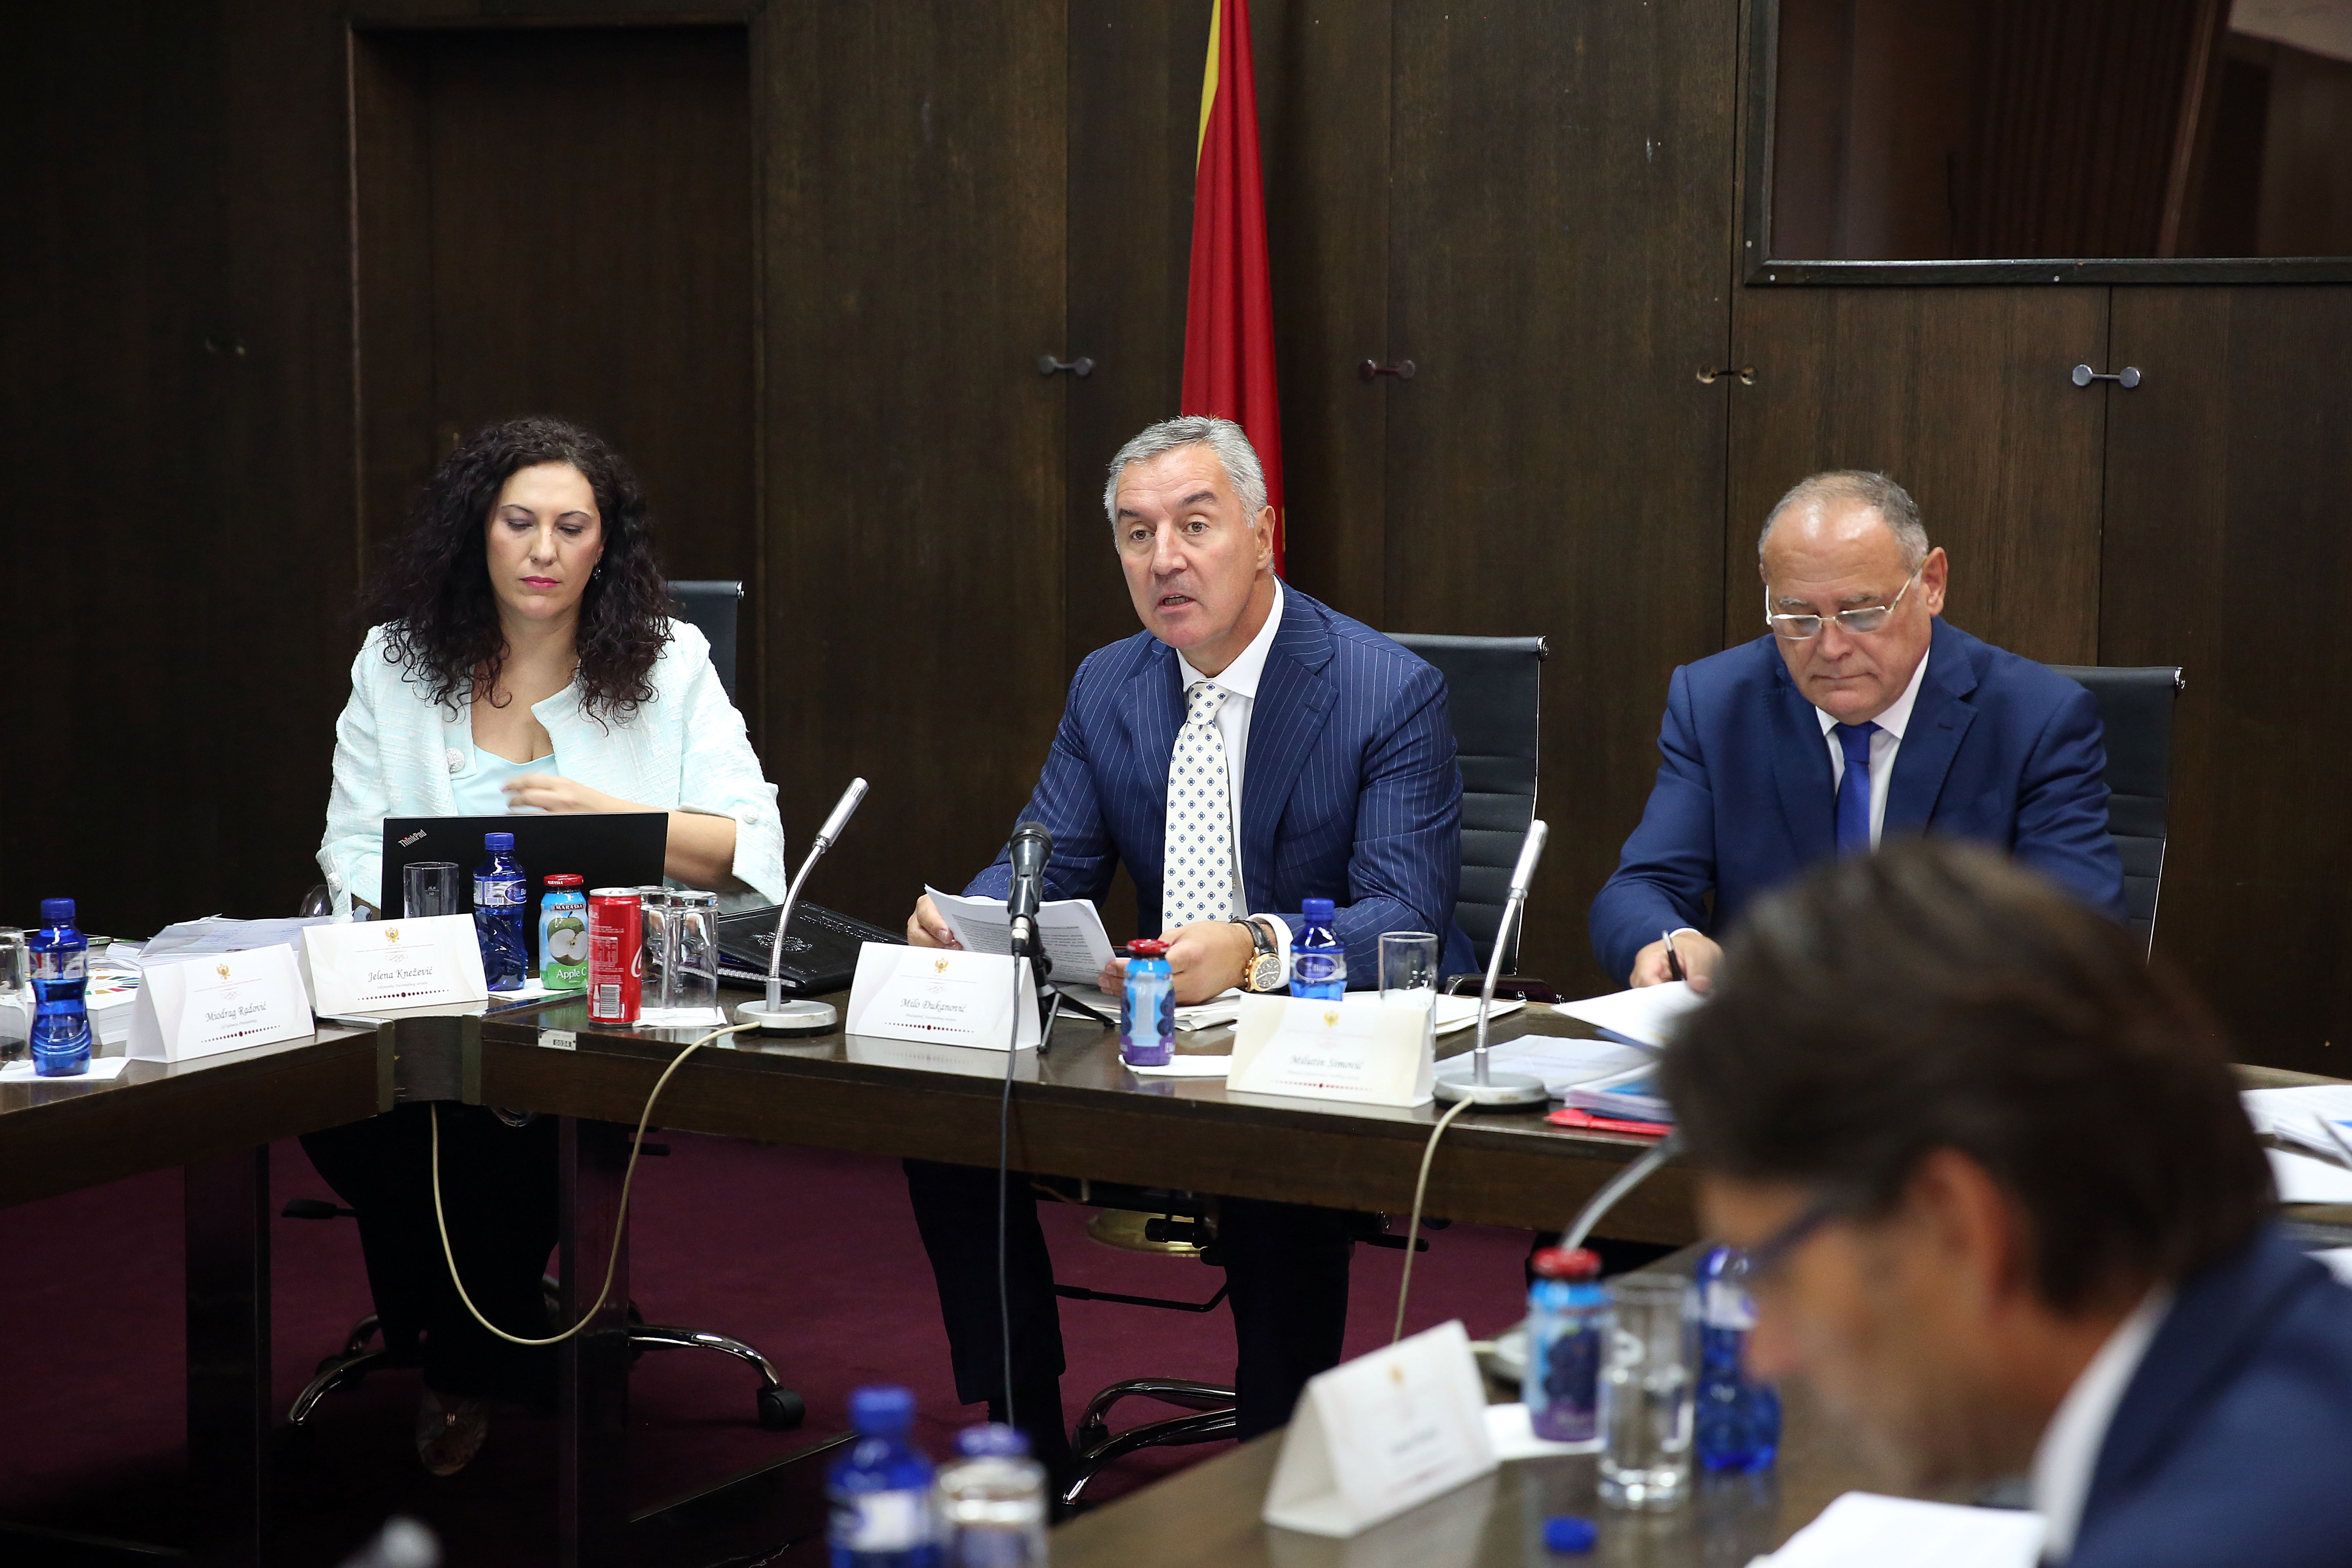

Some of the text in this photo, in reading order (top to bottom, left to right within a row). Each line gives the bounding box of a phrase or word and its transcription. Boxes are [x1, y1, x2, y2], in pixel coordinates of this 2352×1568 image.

[398, 829, 427, 847] ThinkPad
[368, 966, 433, 982] Jelena Knežević
[556, 969, 580, 979] Apple
[900, 998, 920, 1008] Milo
[205, 1001, 266, 1022] Miodrag Radović
